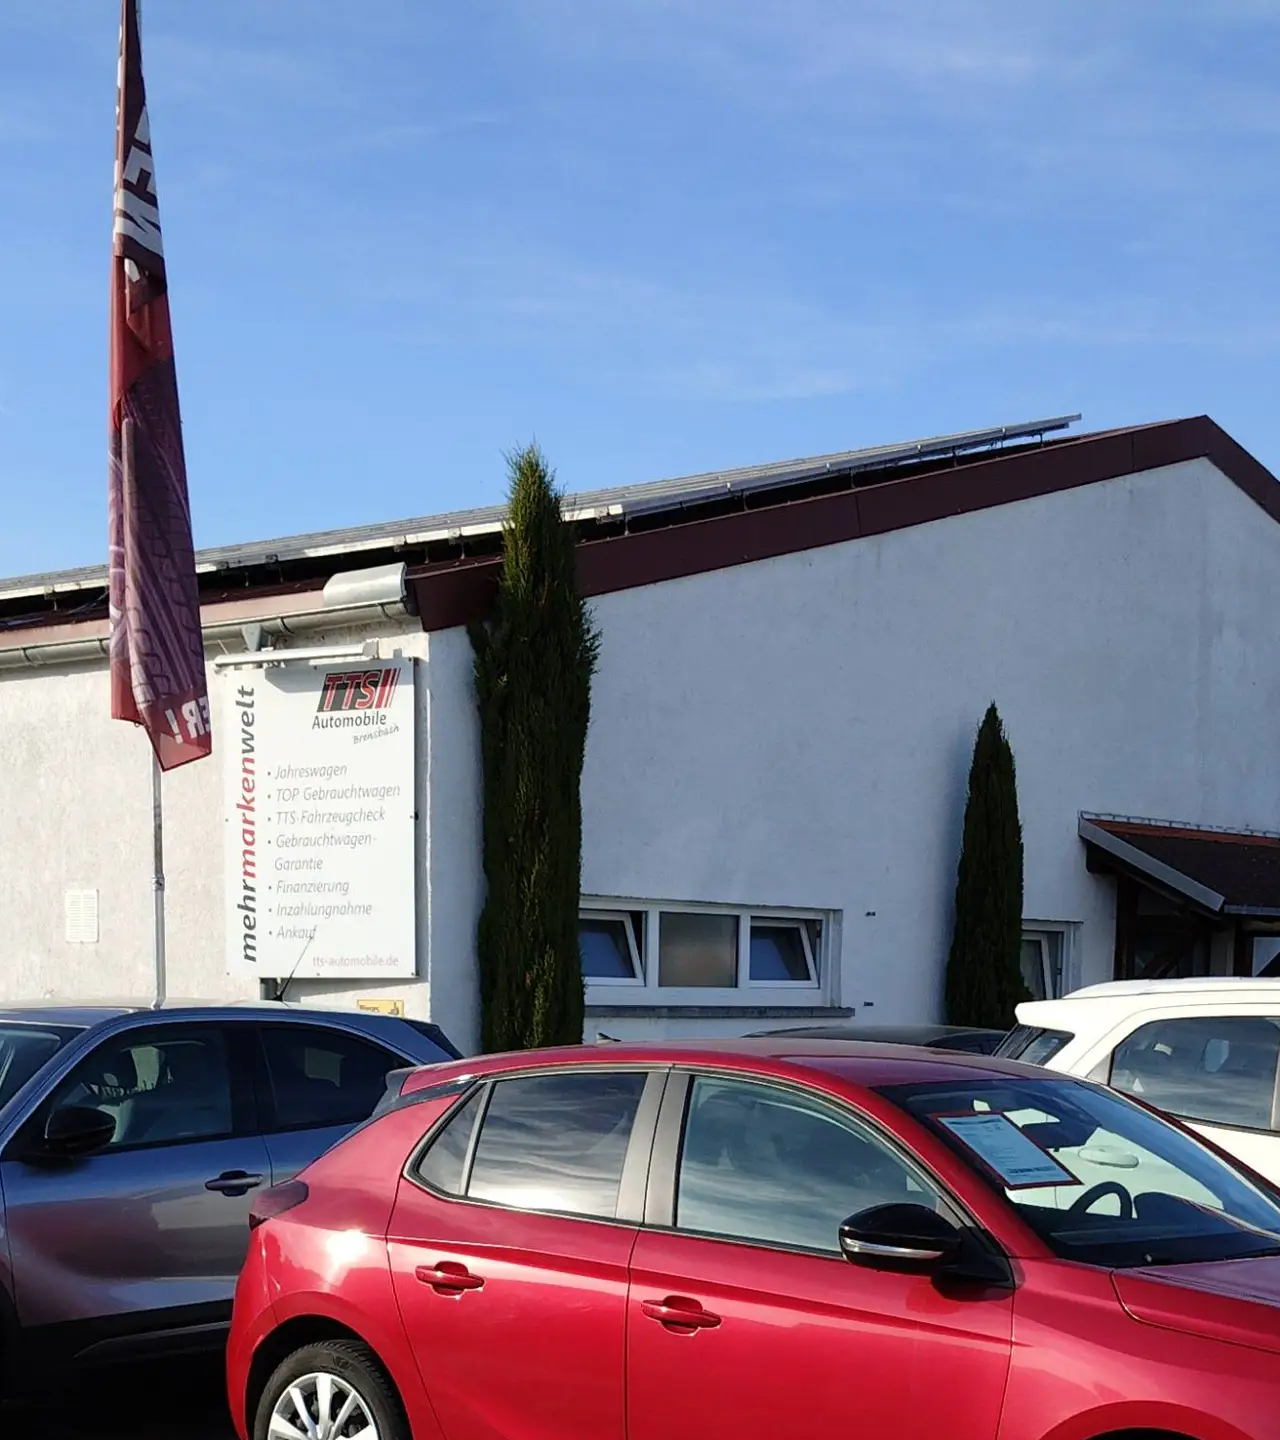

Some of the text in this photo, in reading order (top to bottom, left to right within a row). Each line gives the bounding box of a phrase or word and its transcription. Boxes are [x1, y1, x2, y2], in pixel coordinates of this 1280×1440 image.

[323, 671, 381, 711] TTS
[311, 710, 387, 730] Automobile
[274, 764, 348, 781] Jahreswagen
[276, 784, 401, 802] TOP Gebrauchtwagen
[235, 685, 257, 963] mehrmarkenwelt
[274, 857, 323, 871] Garantie
[276, 880, 350, 896] Finanzierung
[276, 901, 372, 919] Inzahlungnahme
[276, 925, 318, 940] Ankauf
[312, 954, 400, 967] tts-automobile.de
